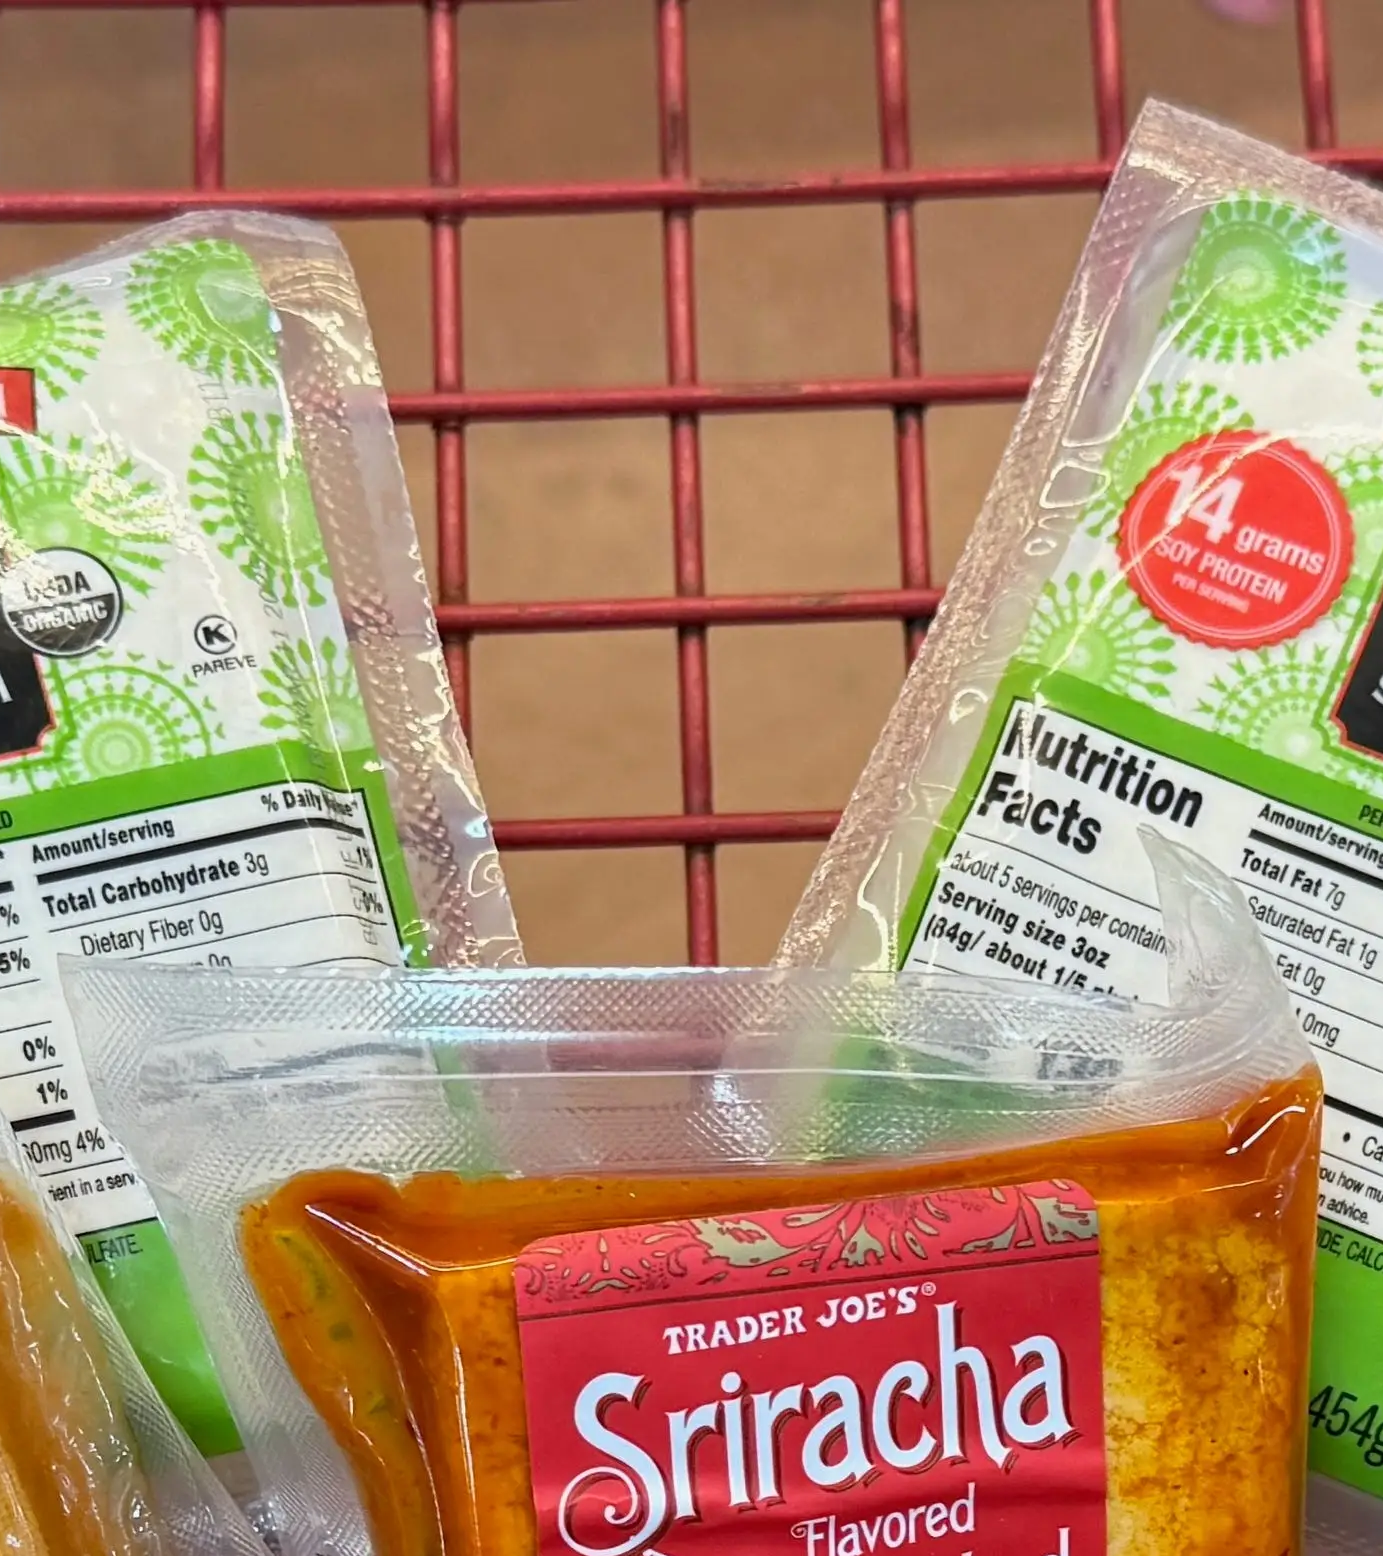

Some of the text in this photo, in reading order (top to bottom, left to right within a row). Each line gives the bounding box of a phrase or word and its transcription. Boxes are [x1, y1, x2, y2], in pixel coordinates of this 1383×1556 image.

[1162, 464, 1327, 575] 14 grams
[1154, 534, 1287, 602] SOY PROTEIN
[191, 654, 257, 678] PAREVE
[1002, 708, 1204, 828] Nutrition
[32, 817, 176, 864] Amount/serving
[977, 770, 1102, 855] Facts
[42, 852, 269, 919] Total Carbohydrate 3g
[1240, 849, 1287, 883] Total
[1290, 870, 1322, 898] Fat
[1324, 882, 1347, 911] 7g
[937, 881, 1112, 969] Serving size 3oz
[1247, 896, 1324, 945] Saturated
[1326, 933, 1356, 959] Fat
[1359, 941, 1379, 970] 1g
[663, 1306, 807, 1355] TRADER
